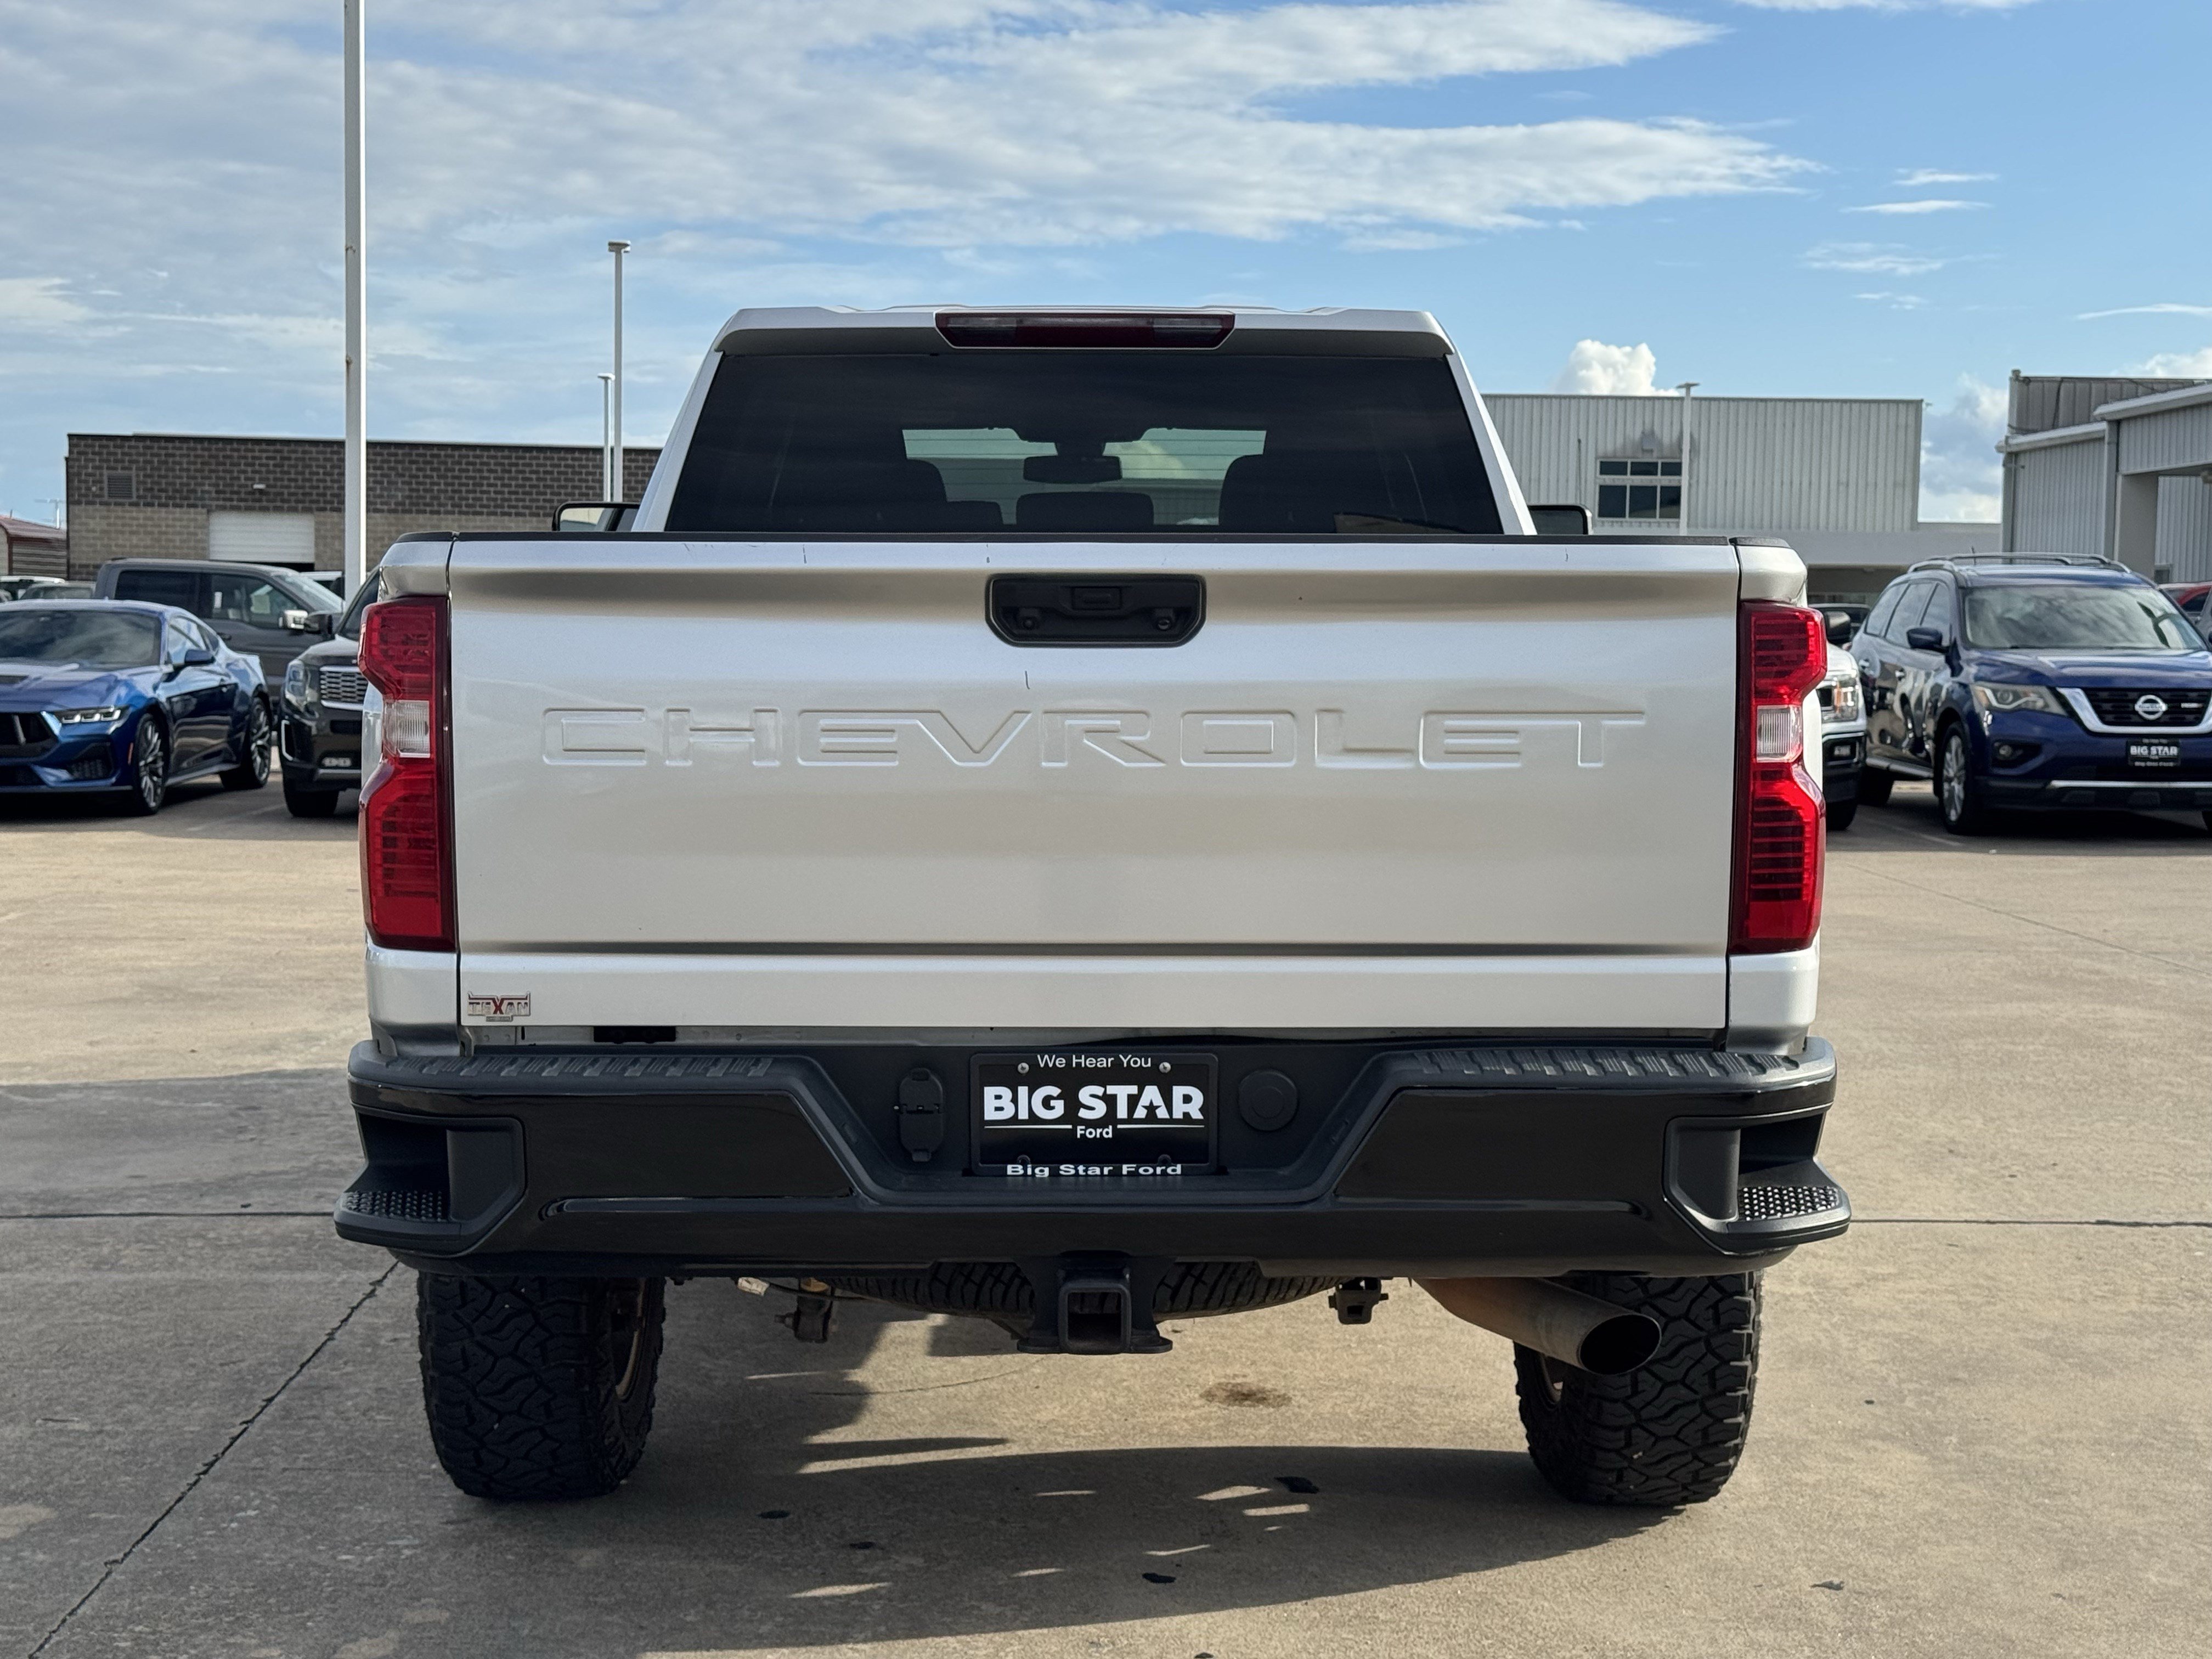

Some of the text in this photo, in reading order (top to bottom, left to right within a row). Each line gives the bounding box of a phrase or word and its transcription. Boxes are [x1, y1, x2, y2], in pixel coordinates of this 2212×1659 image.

[542, 707, 1646, 770] CHEVROLET
[2130, 746, 2178, 756] BIG STAR
[1037, 1054, 1152, 1068] We Hear You
[984, 1085, 1204, 1120] BIG STAR
[1077, 1125, 1113, 1138] Ford
[1006, 1163, 1182, 1177] Big Star Ford
